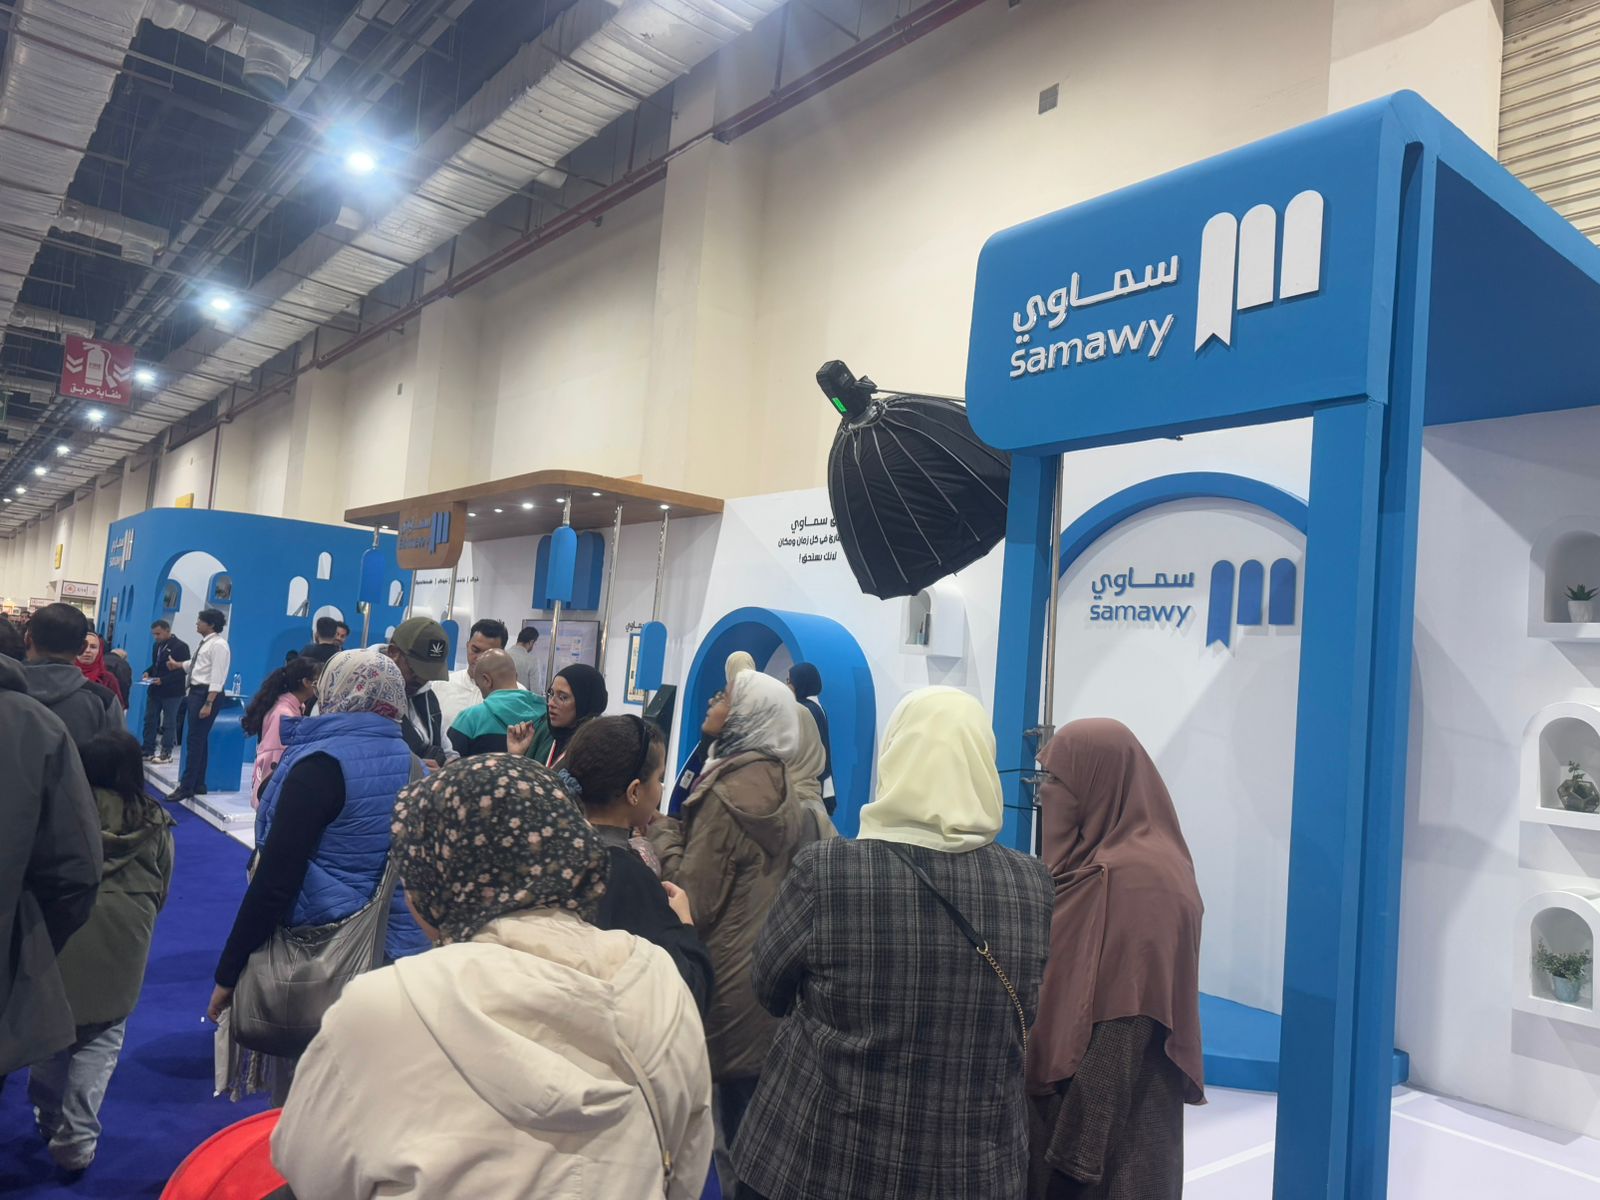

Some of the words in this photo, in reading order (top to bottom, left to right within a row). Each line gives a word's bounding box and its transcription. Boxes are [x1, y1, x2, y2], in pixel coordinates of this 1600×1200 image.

[1012, 255, 1179, 345] سماوي
[1009, 313, 1175, 378] samawy
[70, 383, 94, 395] حريق
[791, 516, 828, 533] سماوي
[1091, 566, 1195, 601] سماوي
[1089, 604, 1192, 628] samawy
